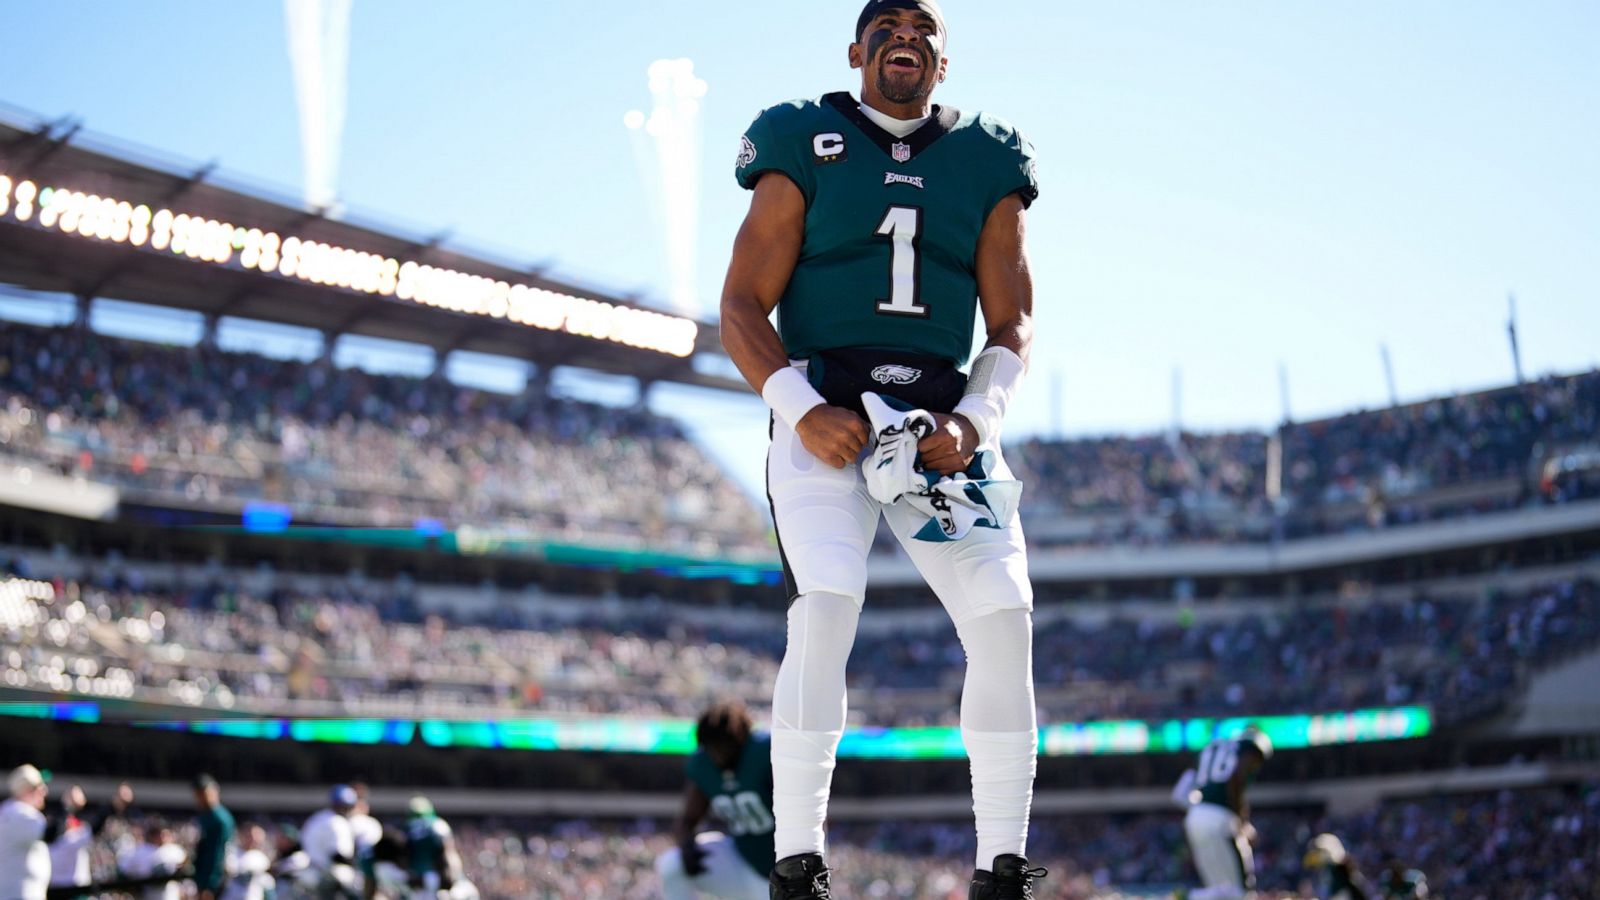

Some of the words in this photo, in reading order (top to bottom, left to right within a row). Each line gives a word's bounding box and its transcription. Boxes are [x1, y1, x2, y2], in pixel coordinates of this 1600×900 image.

[813, 132, 845, 156] C
[884, 171, 925, 189] EAGLES
[875, 204, 929, 317] 1
